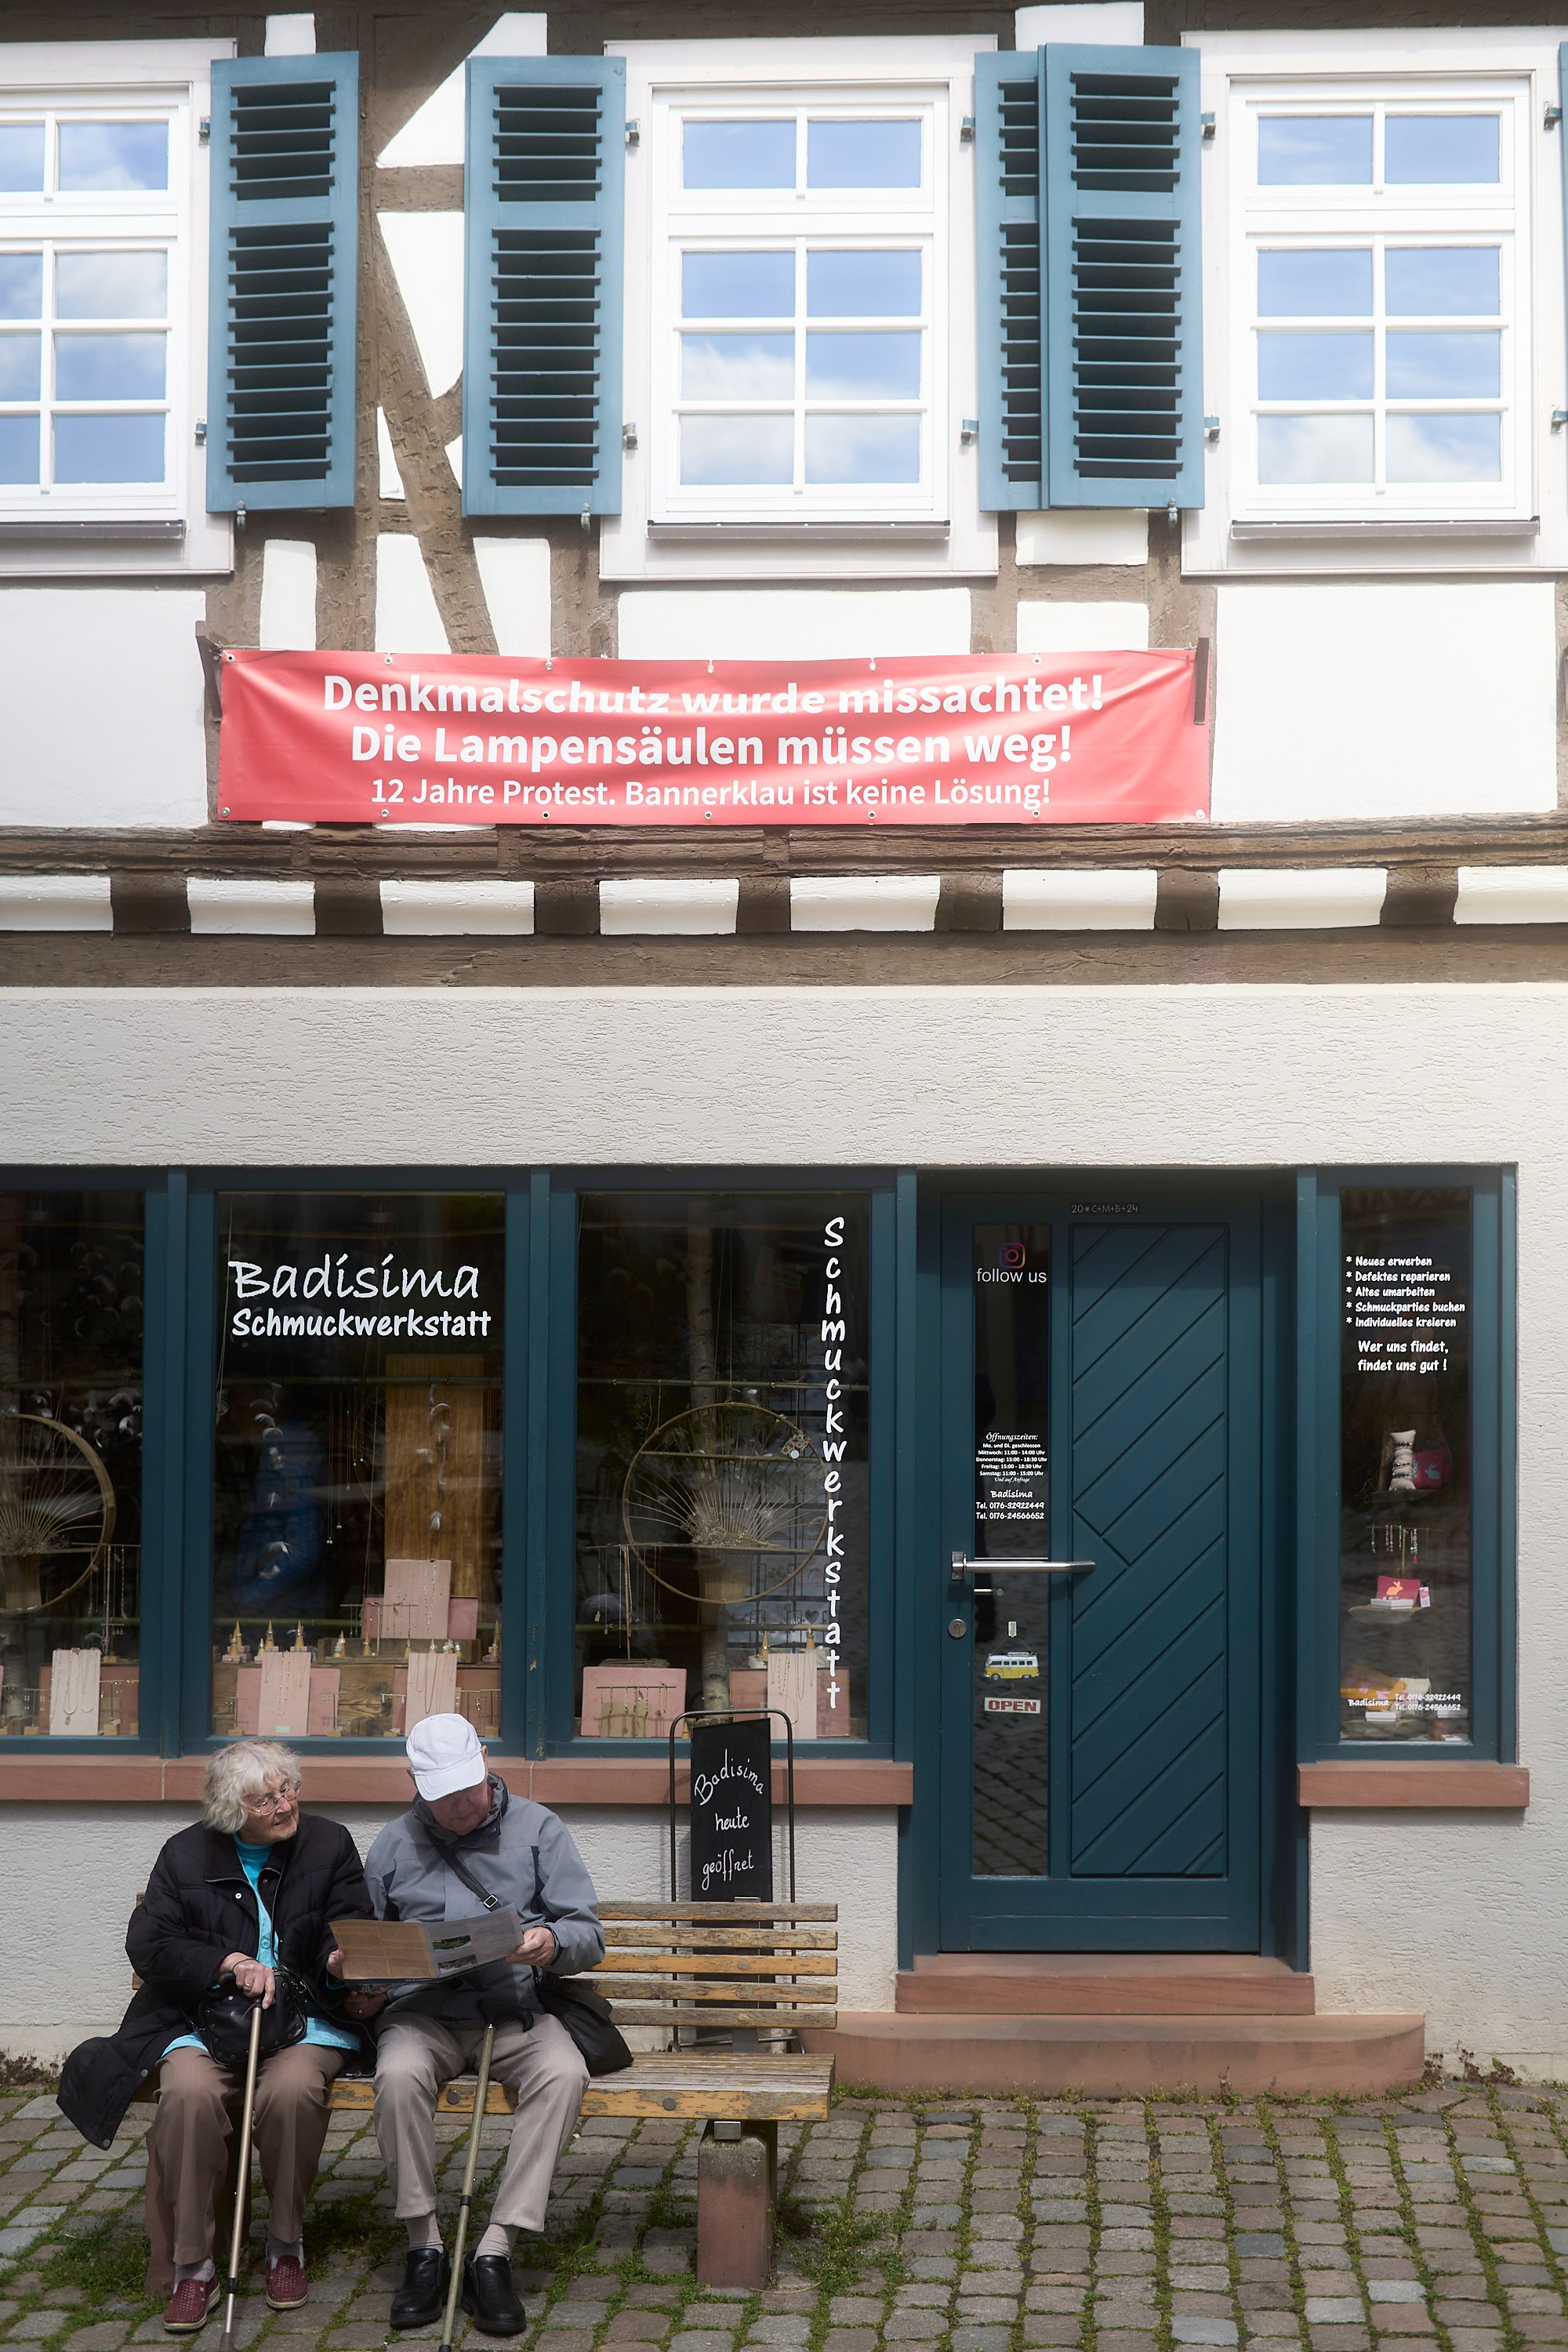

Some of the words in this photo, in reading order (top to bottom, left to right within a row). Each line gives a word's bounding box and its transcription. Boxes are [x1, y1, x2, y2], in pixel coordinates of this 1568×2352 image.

[325, 675, 669, 713] Denkmalschutz
[682, 682, 825, 713] wurde
[839, 675, 1103, 713] missachtet!
[352, 724, 421, 761] Die
[435, 726, 763, 772] Lampensäulen
[779, 726, 950, 764] müssen
[964, 725, 1071, 772] weg!
[372, 779, 404, 803] 12
[412, 778, 494, 805] Jahre
[503, 779, 616, 806] Protest.
[626, 779, 793, 805] Bannerklau
[804, 779, 837, 804] ist
[847, 779, 925, 804] keine
[935, 779, 1050, 810] Lösung!
[1356, 1256, 1385, 1266] Neues
[1388, 1256, 1432, 1266] erwerben
[227, 1254, 478, 1298] Badisima
[976, 1268, 1022, 1283] follow
[1029, 1272, 1047, 1283] us
[1356, 1271, 1398, 1282] Defektes
[1401, 1272, 1450, 1283] reparieren
[1356, 1287, 1380, 1297] Altes
[1382, 1287, 1435, 1297] umarbeiten
[1356, 1301, 1429, 1314] Schmuckparties
[1433, 1301, 1465, 1312] buchen
[231, 1308, 491, 1337] Schmuckwerkstatt
[1356, 1317, 1413, 1327] Individuelles
[1416, 1317, 1456, 1327] kreieren
[1358, 1341, 1383, 1352] Wer
[1386, 1343, 1406, 1352] uns
[1410, 1341, 1449, 1354] findet,
[1358, 1359, 1392, 1371] findet
[1396, 1362, 1416, 1371] uns
[1420, 1359, 1439, 1374] gut
[986, 1432, 1038, 1442] Öffnungszeiten:
[821, 1217, 848, 1709] Schmuckwerkstatt
[990, 1490, 1033, 1498] Badisima
[988, 1700, 1036, 1711] OPEN
[694, 1748, 763, 1806] Badisima
[715, 1806, 750, 1831] heute
[702, 1849, 754, 1891] geöffnet
